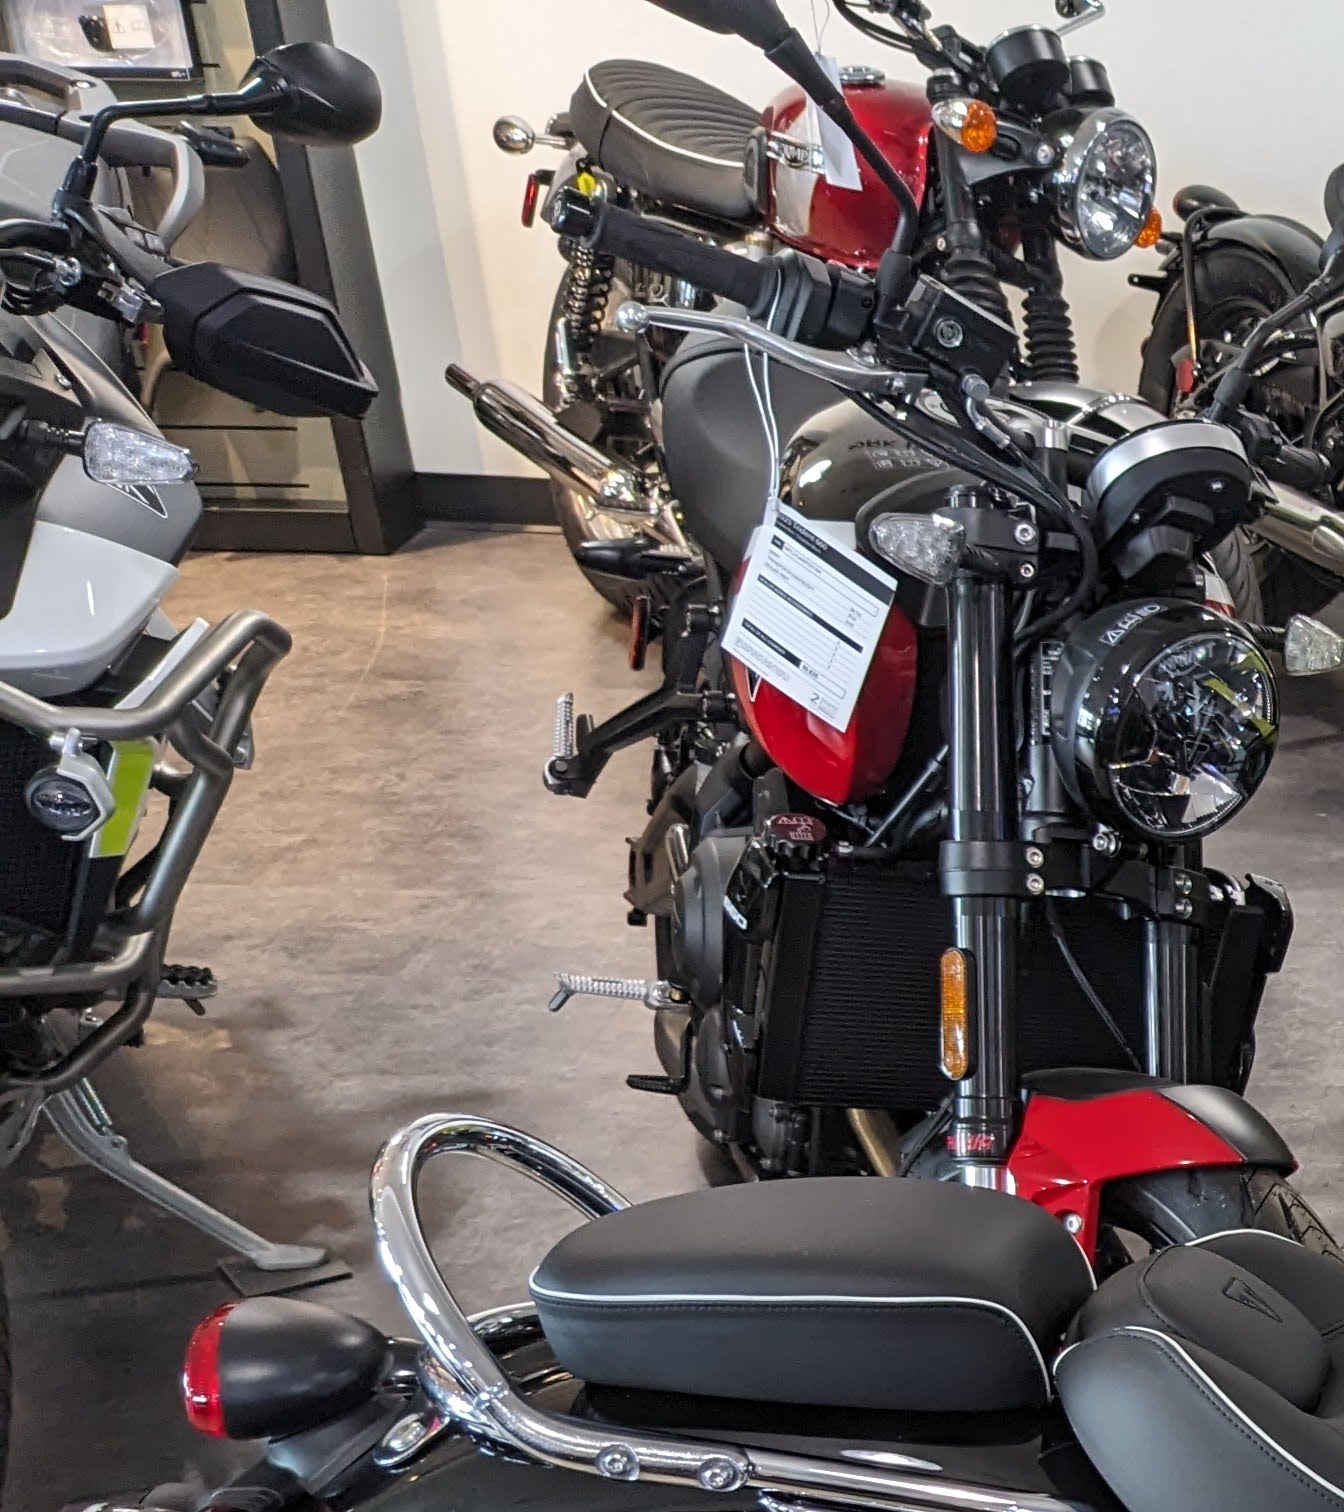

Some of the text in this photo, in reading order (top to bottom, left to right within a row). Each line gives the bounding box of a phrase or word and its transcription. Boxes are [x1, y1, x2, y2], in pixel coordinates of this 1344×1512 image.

[790, 522, 817, 542] Trident
[813, 537, 829, 550] 660
[808, 691, 821, 704] 2
